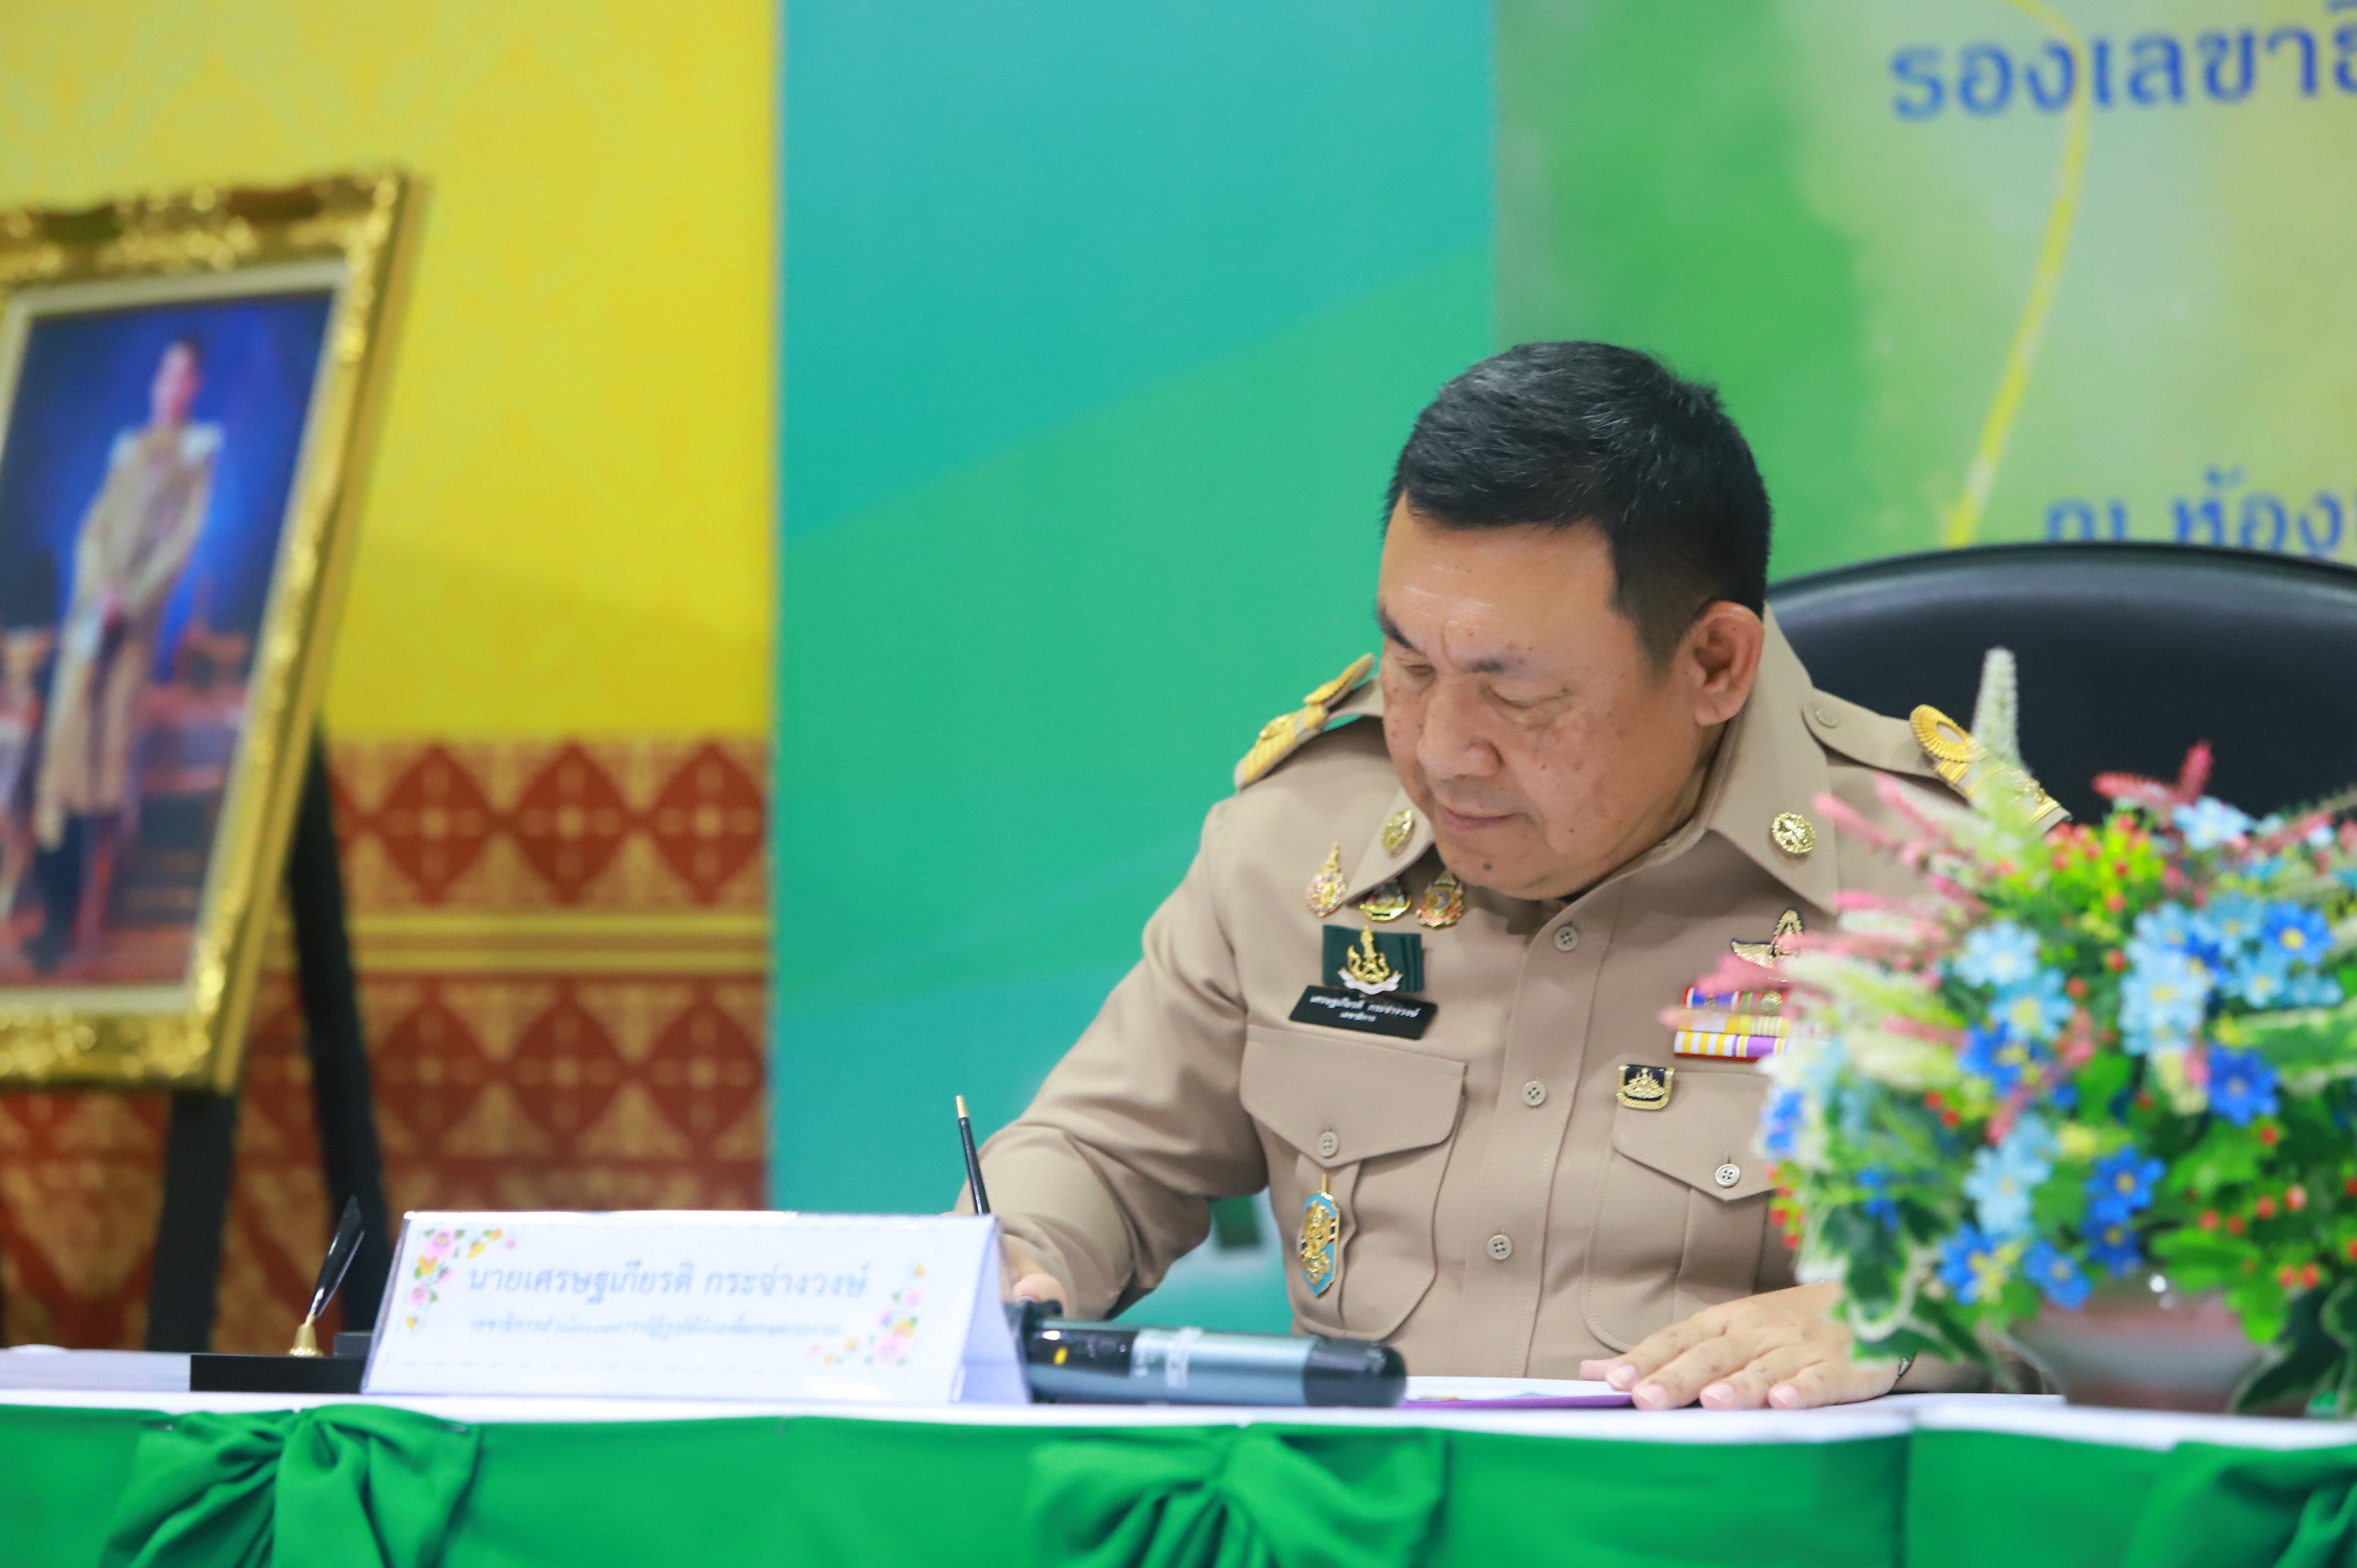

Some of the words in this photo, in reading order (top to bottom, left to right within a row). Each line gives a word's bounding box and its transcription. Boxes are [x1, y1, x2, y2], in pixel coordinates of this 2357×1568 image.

[1890, 0, 2357, 120] รองเลขา
[2171, 465, 2357, 560] ห้อง
